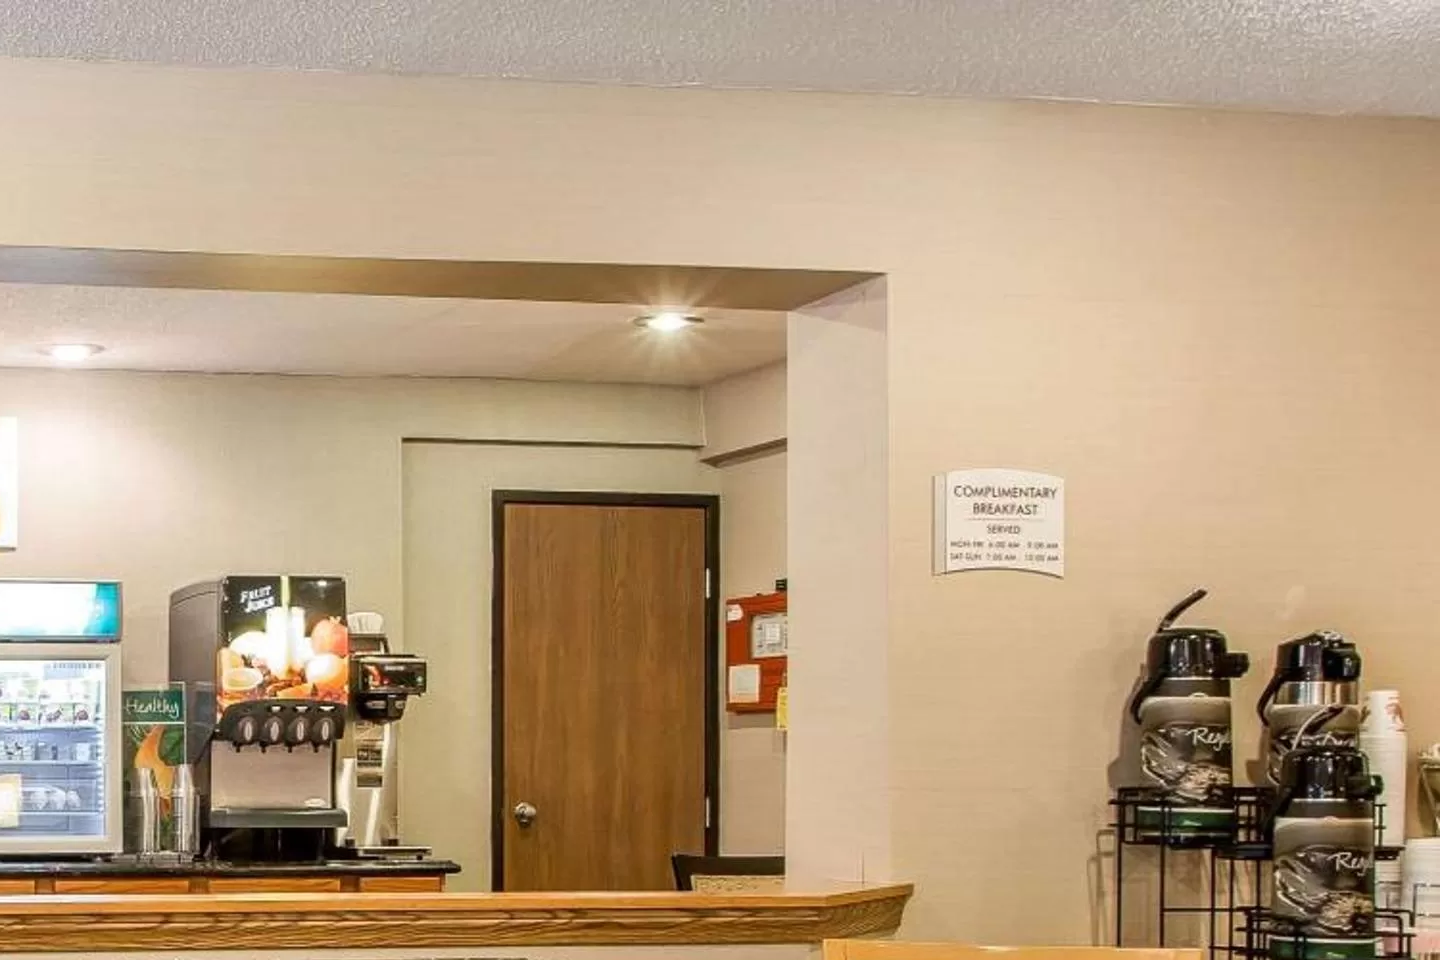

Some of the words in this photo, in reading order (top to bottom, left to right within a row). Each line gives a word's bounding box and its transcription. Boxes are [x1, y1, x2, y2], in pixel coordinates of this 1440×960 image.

[953, 485, 1057, 500] COMPLIMENTARY
[972, 502, 1039, 516] BREAKFAST
[986, 524, 1021, 535] SERVED
[124, 696, 180, 719] Healthy
